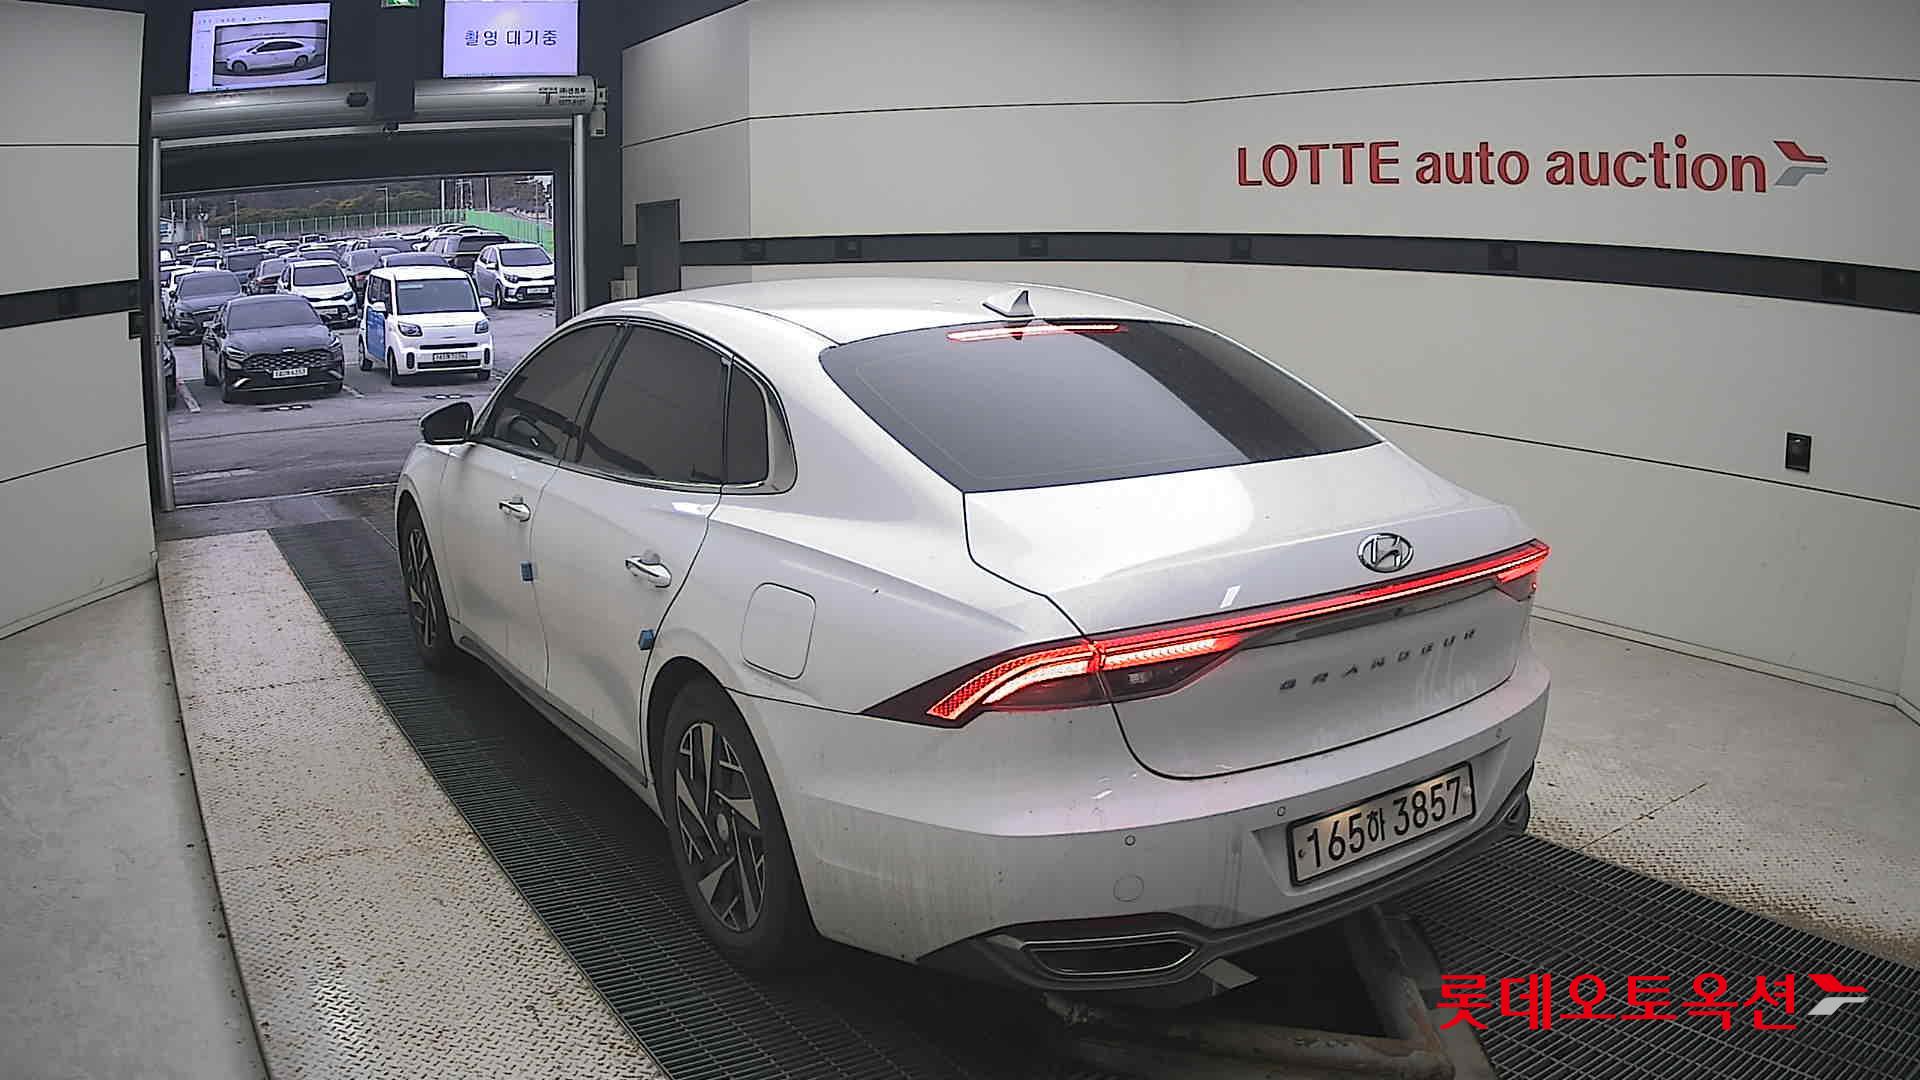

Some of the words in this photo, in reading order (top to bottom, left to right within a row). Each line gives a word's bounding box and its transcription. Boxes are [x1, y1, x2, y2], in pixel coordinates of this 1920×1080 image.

[506, 29, 558, 47] 대기중
[1237, 140, 1400, 188] LOTTE
[1415, 141, 1530, 185] auto
[1545, 133, 1767, 193] auction
[1279, 628, 1476, 691] GRANDEUR
[1306, 807, 1386, 869] 165하
[1392, 775, 1462, 837] 3857
